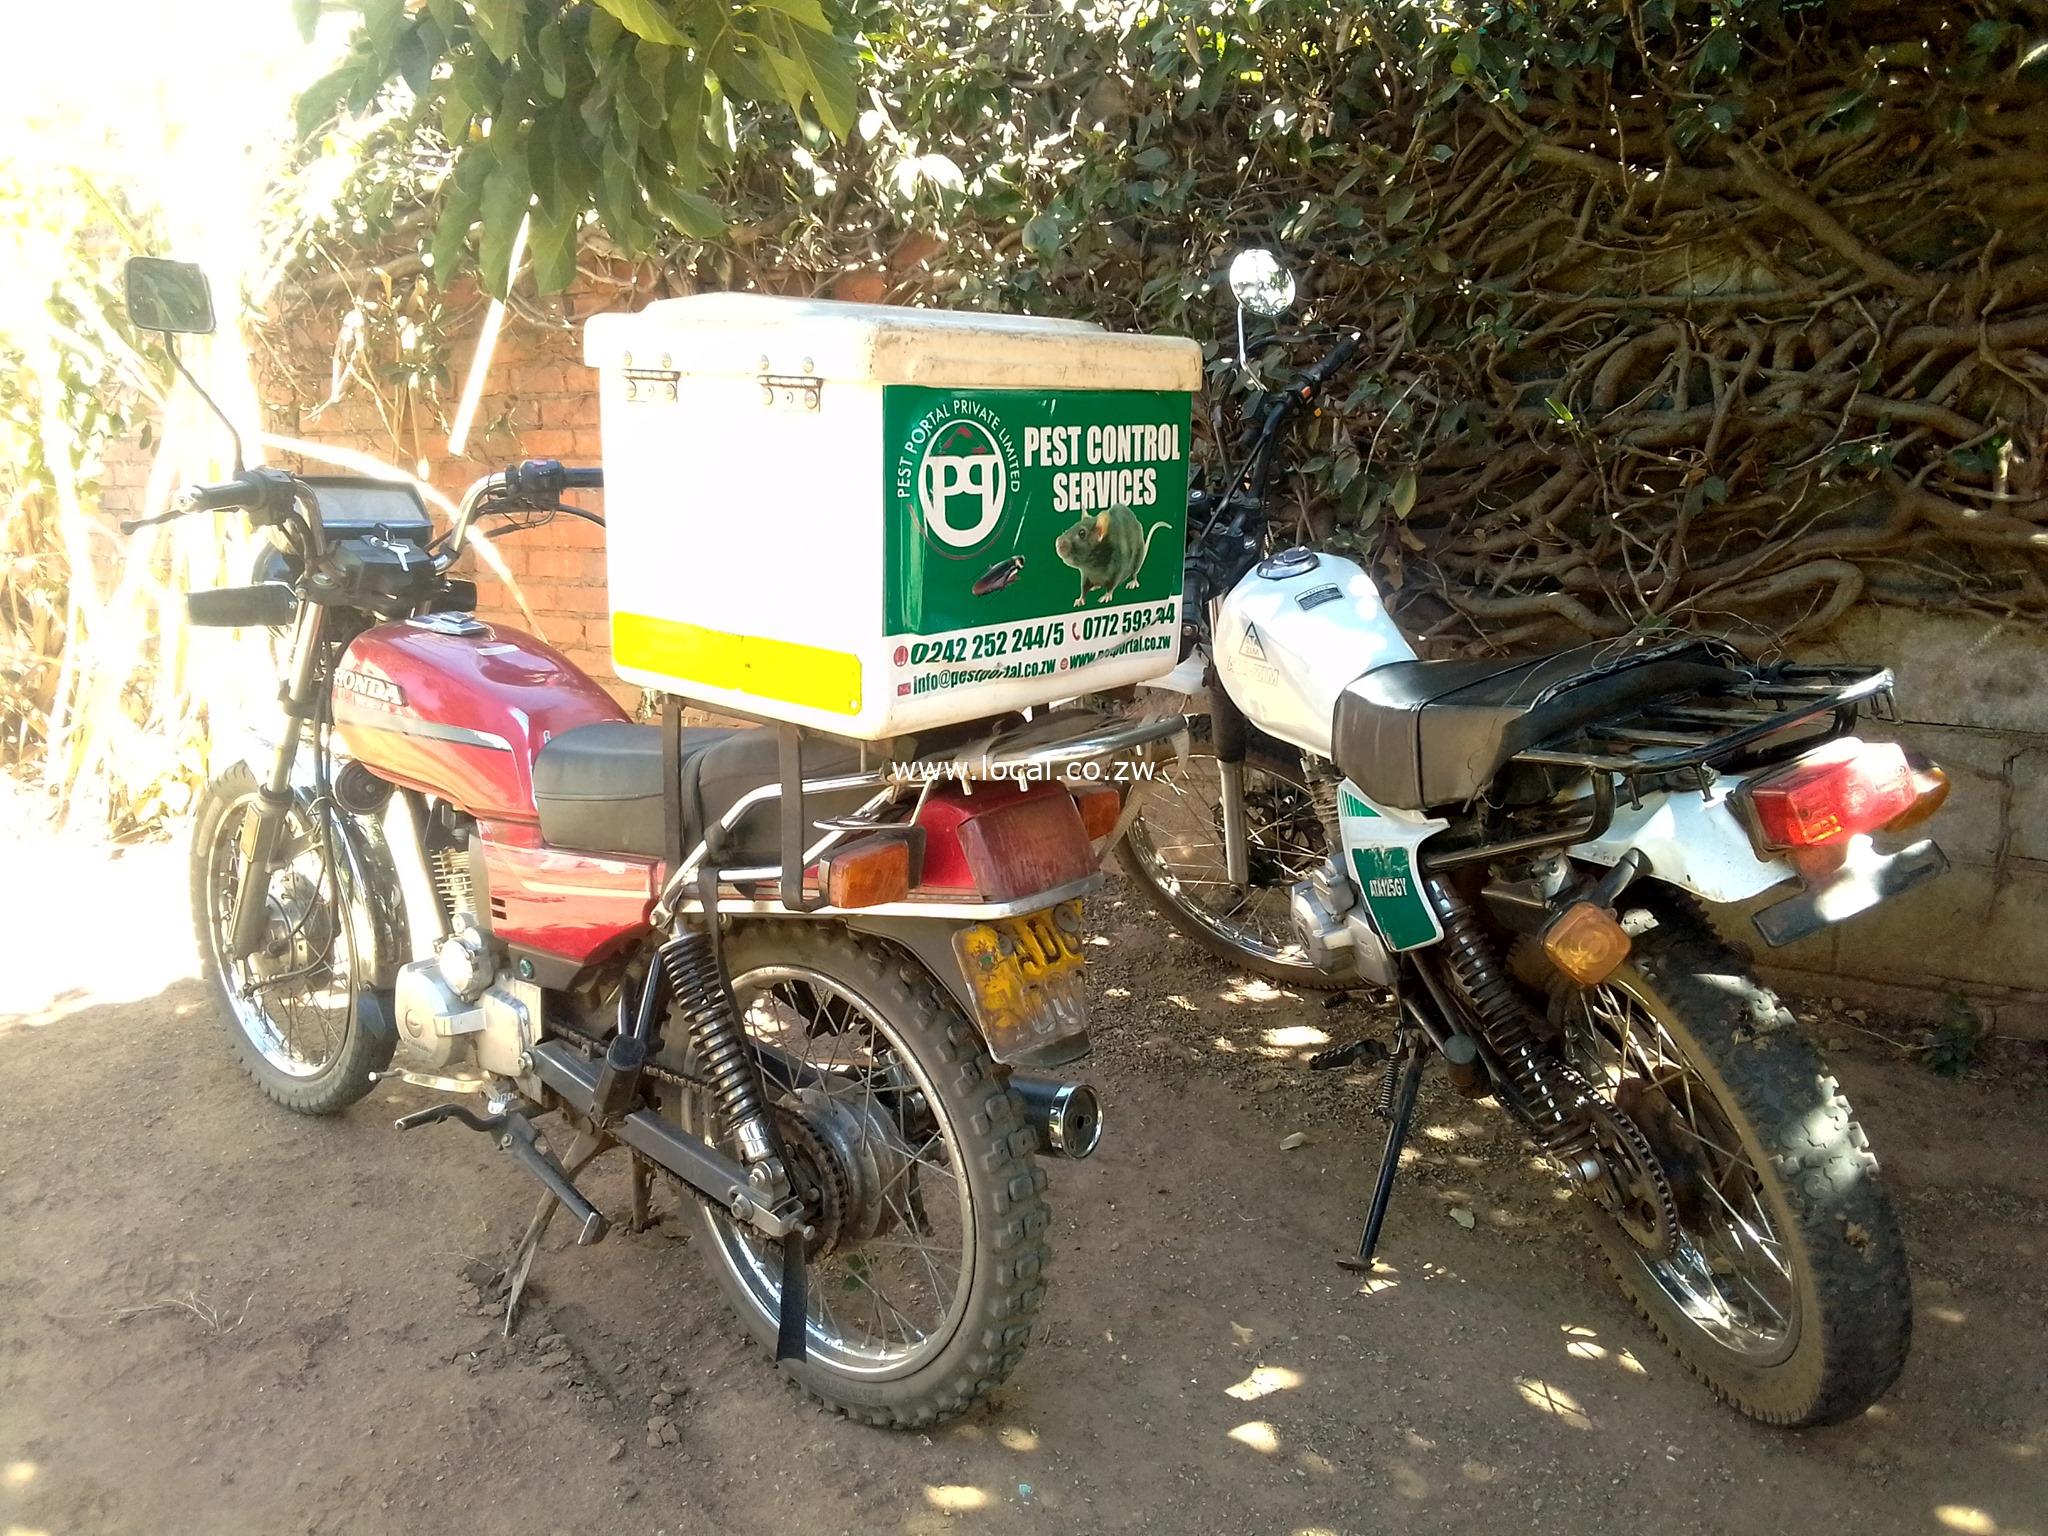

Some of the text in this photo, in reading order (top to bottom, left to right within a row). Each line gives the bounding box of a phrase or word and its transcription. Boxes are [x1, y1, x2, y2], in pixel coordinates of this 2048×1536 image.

[897, 399, 1021, 498] PEST PORTAL PRIVATE LIMITED
[1024, 423, 1181, 467] PEST CONTROL
[1053, 468, 1158, 513] SERVICES
[910, 622, 1065, 666] 0242 252 244/5
[1083, 613, 1118, 641] 0772
[1121, 608, 1151, 634] 593
[334, 668, 403, 706] HONDA
